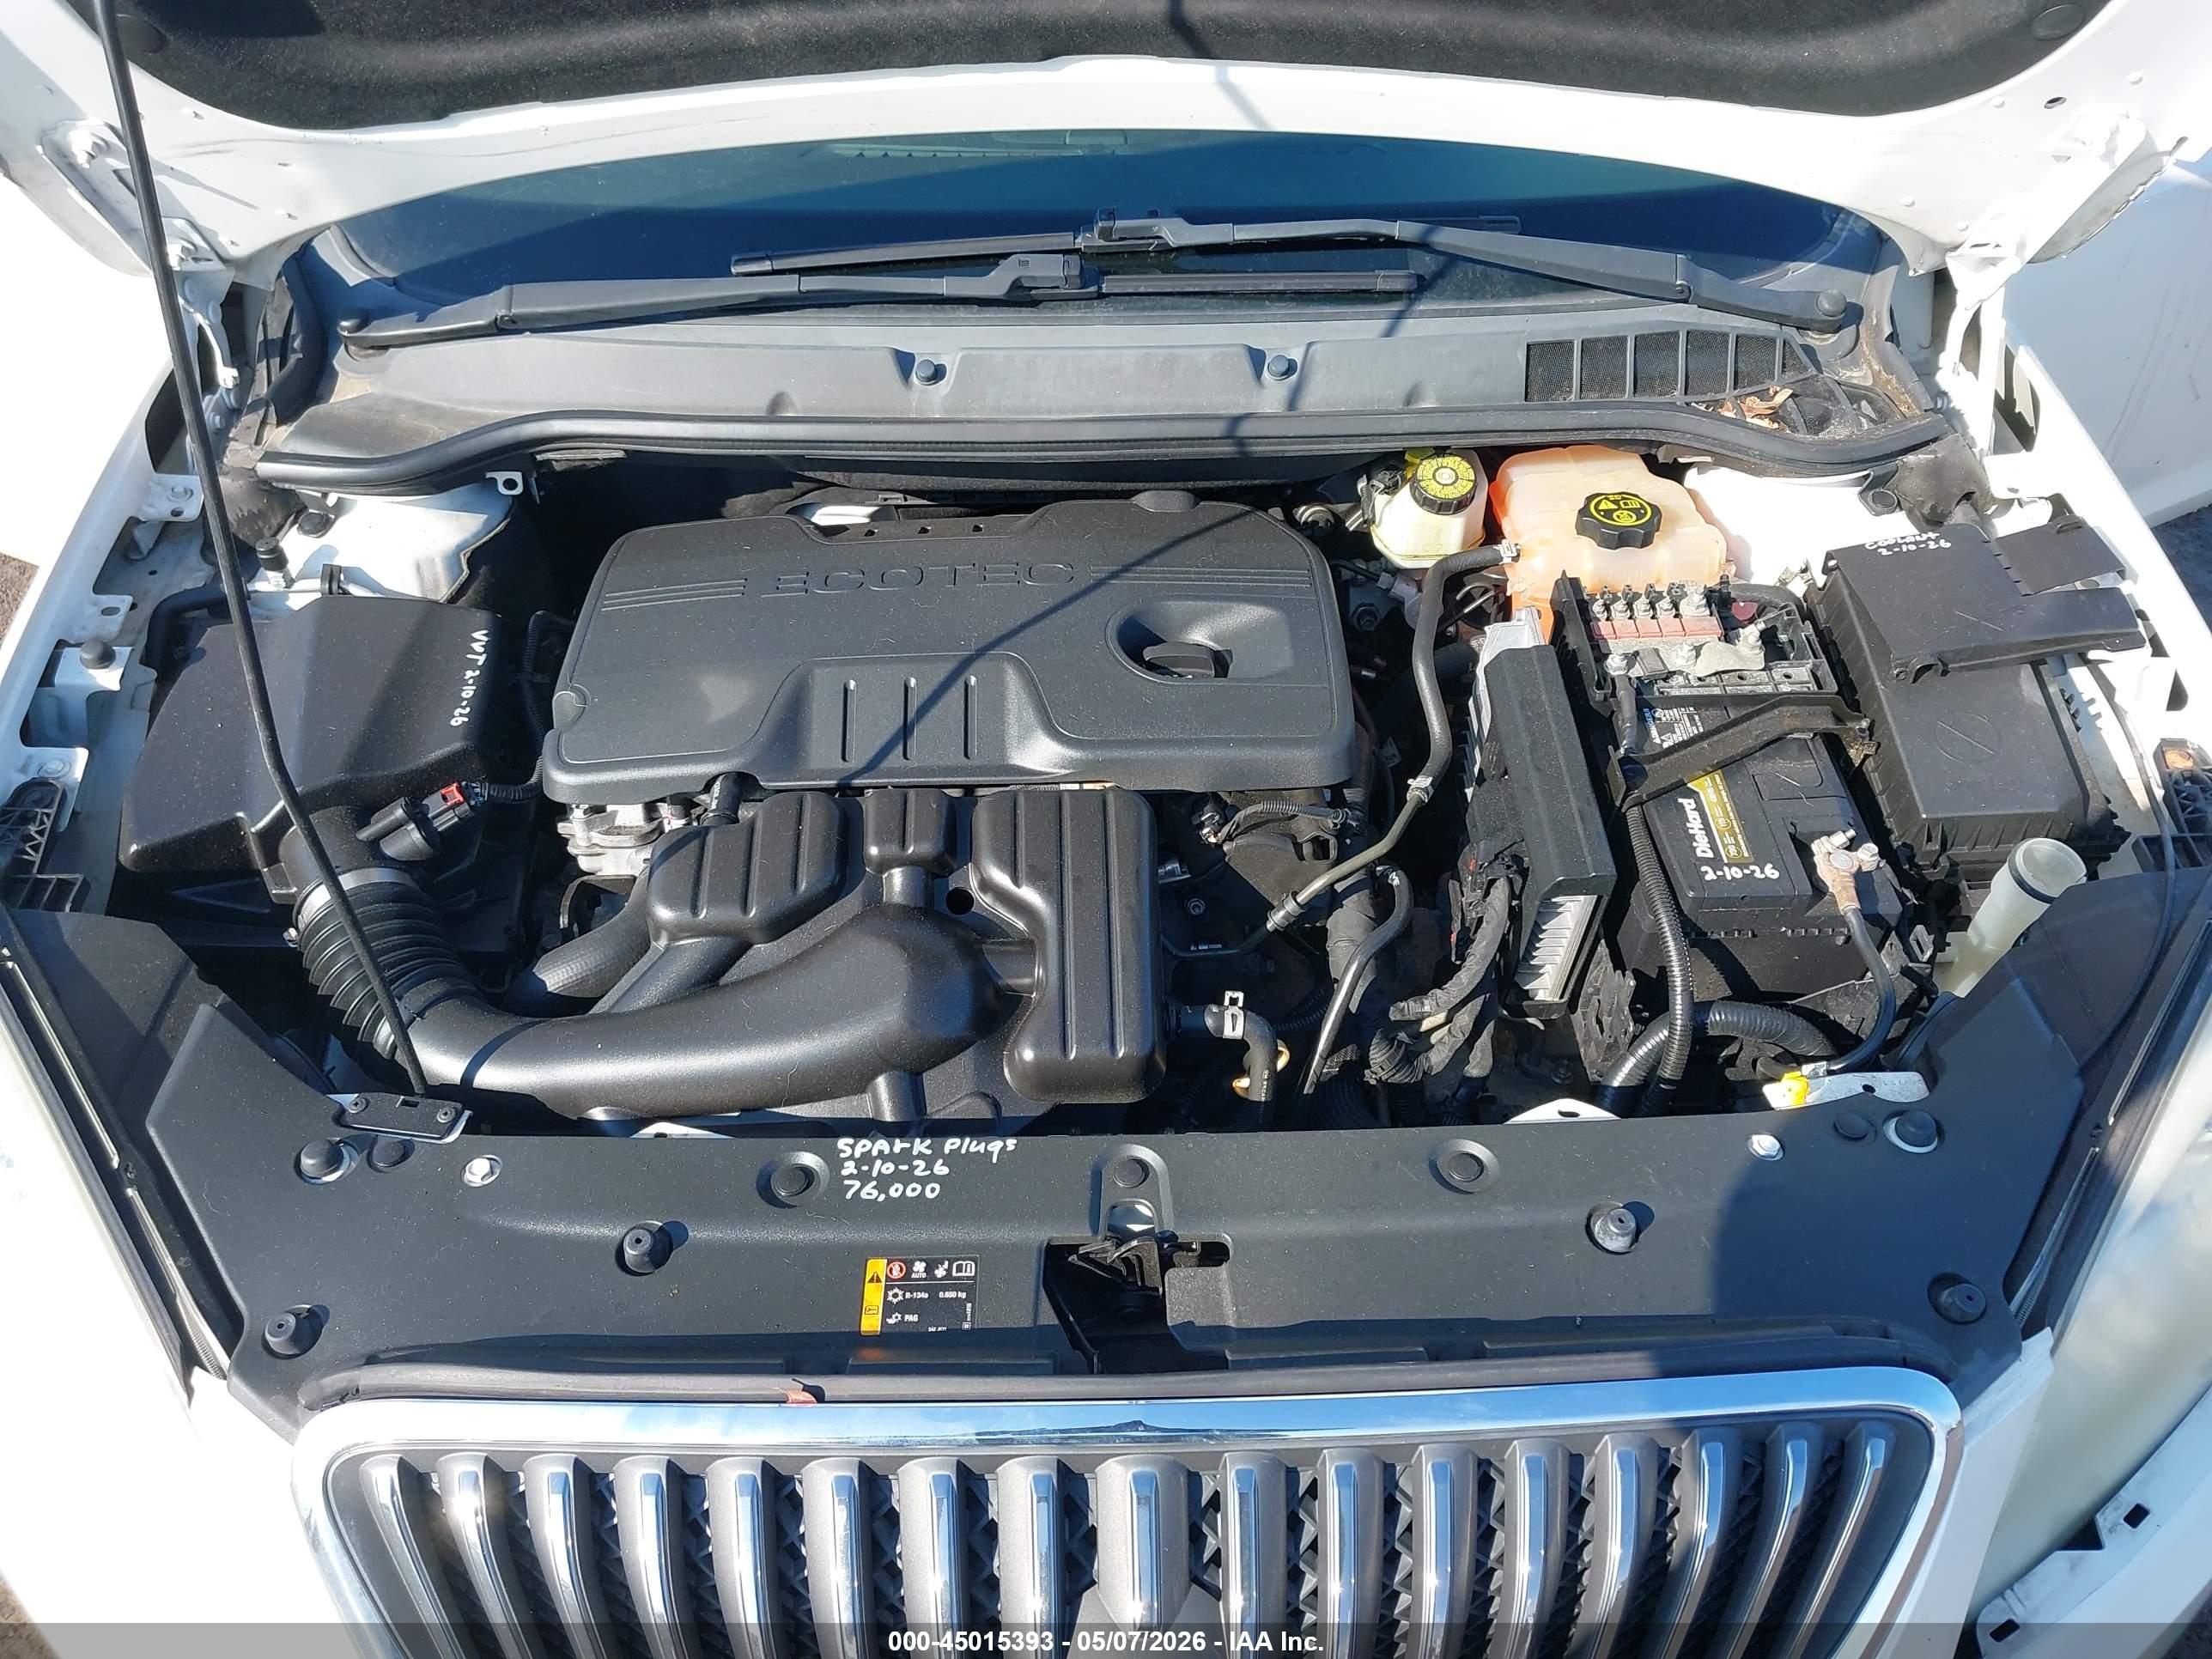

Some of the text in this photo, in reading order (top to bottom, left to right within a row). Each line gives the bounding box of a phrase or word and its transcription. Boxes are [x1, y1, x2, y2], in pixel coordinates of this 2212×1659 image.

[1877, 539, 1952, 556] 2-10-26
[761, 562, 1075, 597] ECOTEC
[1677, 798, 1715, 858] DieHard
[1701, 863, 1780, 880] 2-10-26
[841, 1158, 950, 1177] 2-10-26
[843, 1179, 941, 1202] 76,000
[957, 1291, 967, 1299] kg
[904, 1314, 919, 1322] PAG
